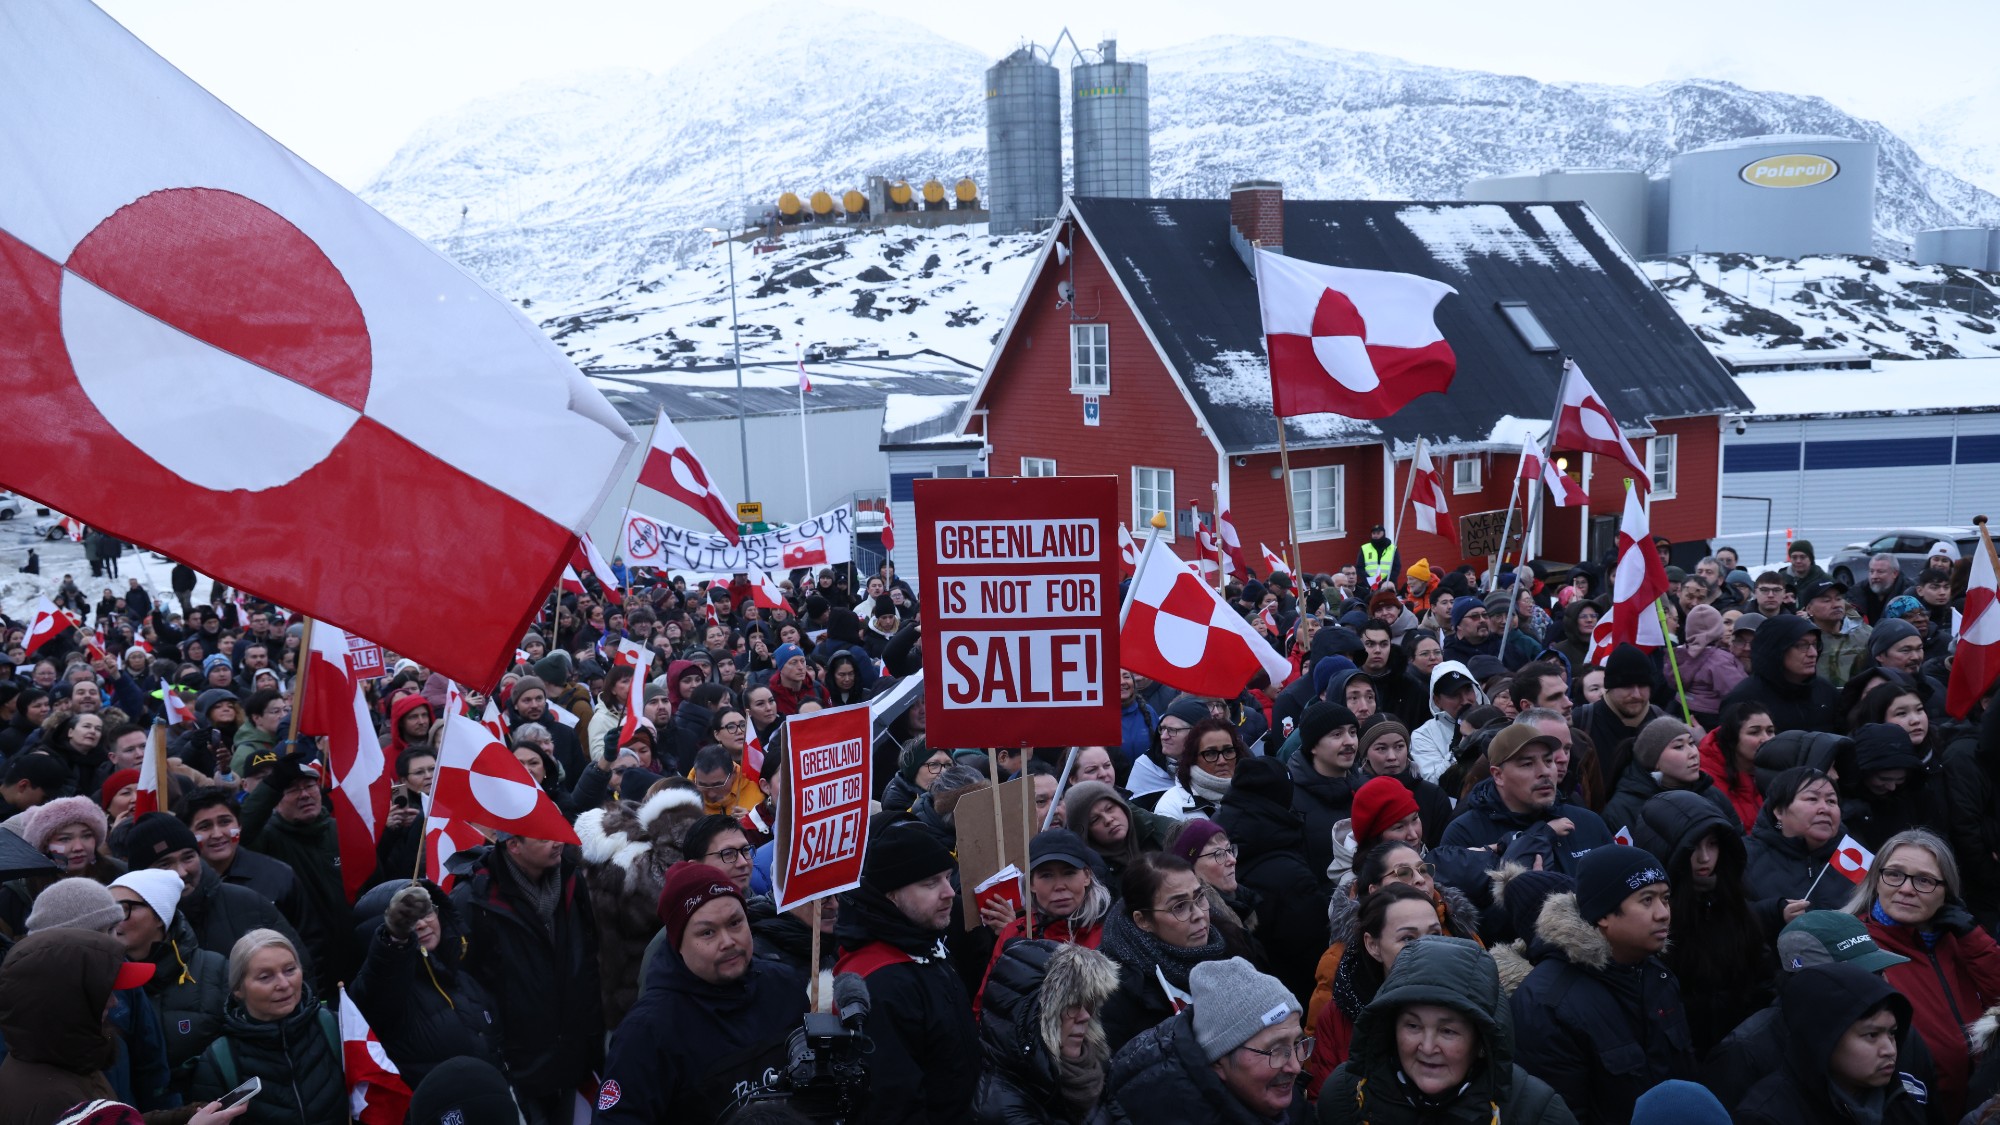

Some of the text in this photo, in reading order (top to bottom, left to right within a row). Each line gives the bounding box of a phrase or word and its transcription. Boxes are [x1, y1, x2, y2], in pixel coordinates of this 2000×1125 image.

[1755, 163, 1828, 179] Polaroil
[656, 523, 700, 547] WE
[799, 508, 850, 538] OUR
[1466, 512, 1511, 528] WE AR
[1468, 525, 1514, 541] NOT FO
[632, 524, 652, 553] TRUMP
[940, 524, 1095, 559] GREENLAND
[1468, 537, 1511, 557] SAL
[660, 541, 779, 570] FUTURE
[943, 579, 1096, 614] IS NOT FOR
[351, 649, 379, 668] ALE!
[946, 634, 1098, 705] SALE!
[802, 741, 861, 776] GREENLAND
[804, 776, 860, 813] IS NOT FOR
[798, 811, 859, 871] SALE!
